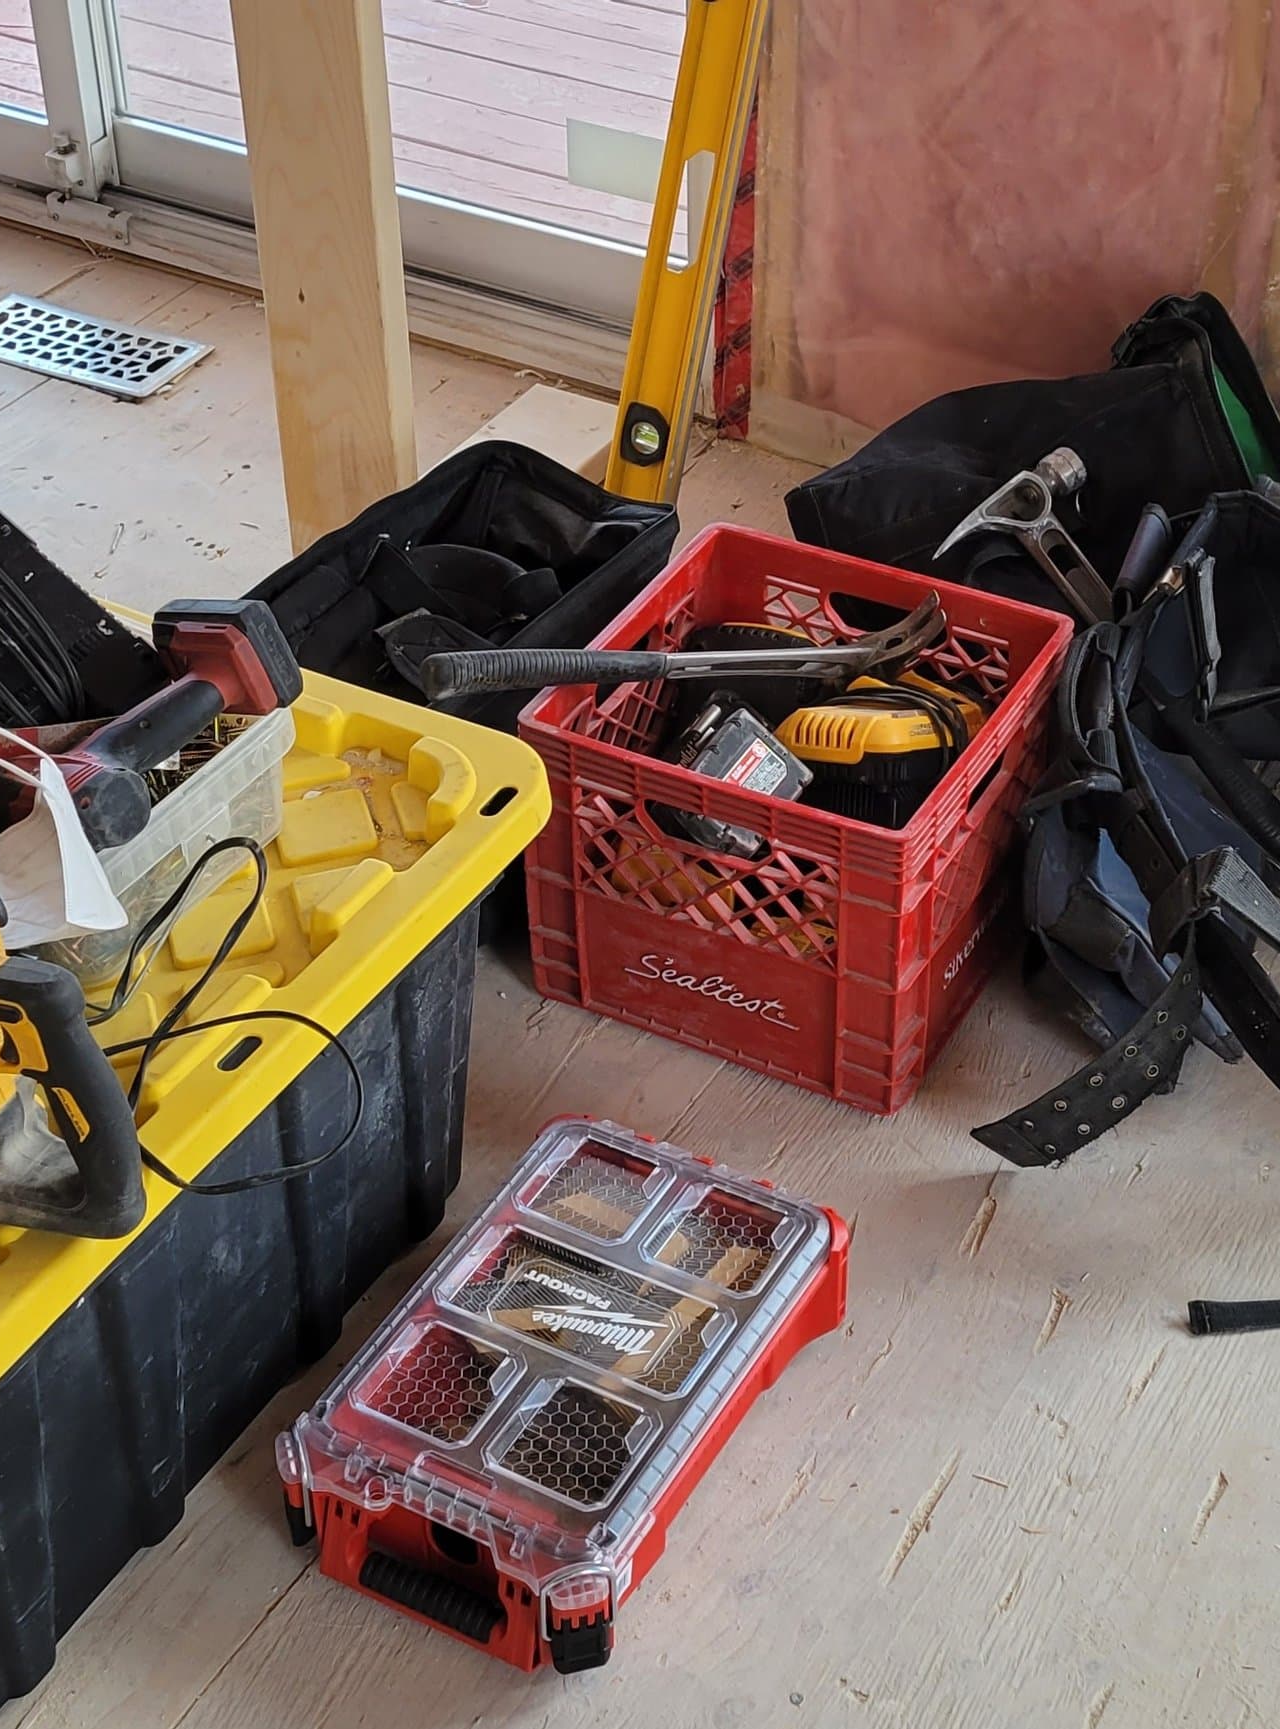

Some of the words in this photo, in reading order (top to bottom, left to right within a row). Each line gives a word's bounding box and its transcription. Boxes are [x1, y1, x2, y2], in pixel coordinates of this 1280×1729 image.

[624, 954, 800, 1031] Sealtest
[524, 1269, 611, 1310] PACKOUT
[531, 1310, 655, 1356] Milwaukee
